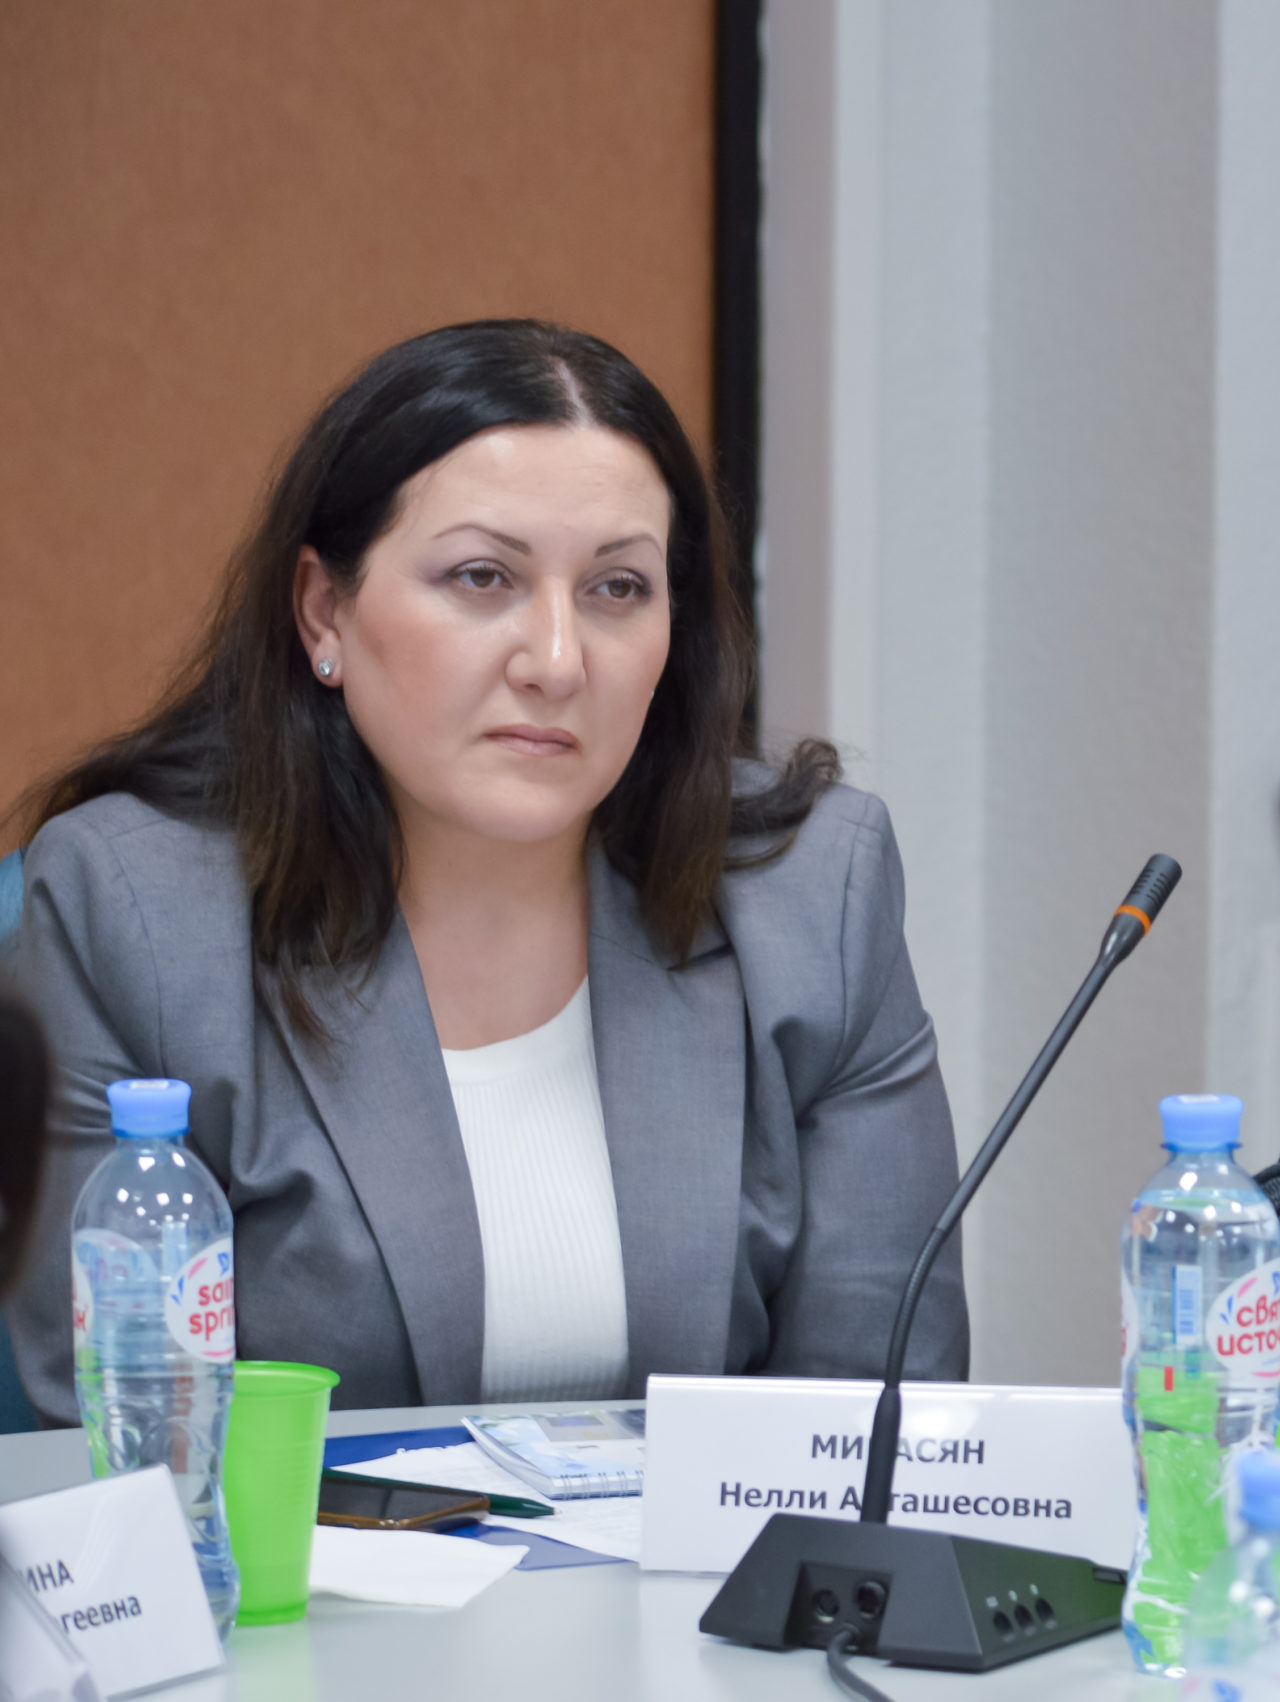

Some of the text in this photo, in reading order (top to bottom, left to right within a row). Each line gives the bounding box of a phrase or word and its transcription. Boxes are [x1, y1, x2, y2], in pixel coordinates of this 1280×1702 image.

[811, 1434, 985, 1464] МИАСЯН
[719, 1482, 1073, 1519] Нелли Аташесовна
[60, 1596, 142, 1634] геевна
